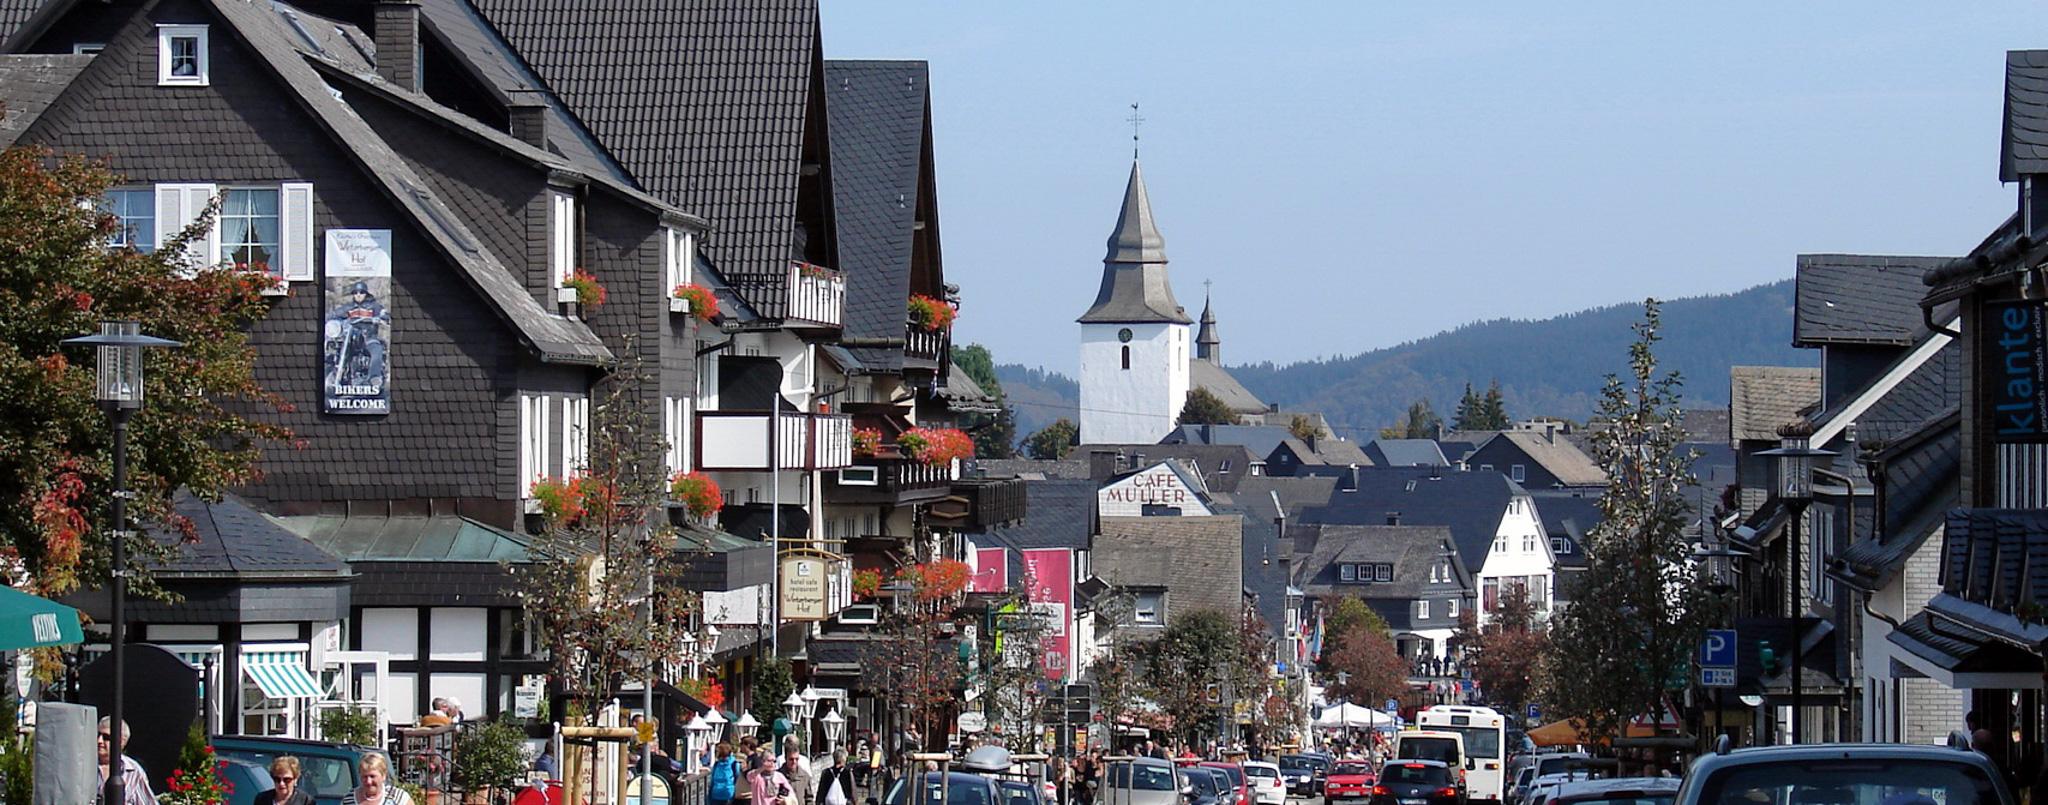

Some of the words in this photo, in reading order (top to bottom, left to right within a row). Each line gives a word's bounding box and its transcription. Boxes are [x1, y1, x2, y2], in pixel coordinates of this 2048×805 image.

[1997, 307, 2035, 435] klante
[2036, 346, 2045, 382] modisch
[335, 385, 380, 395] BIKERS
[328, 399, 386, 409] WELCOME
[1706, 635, 1725, 662] P
